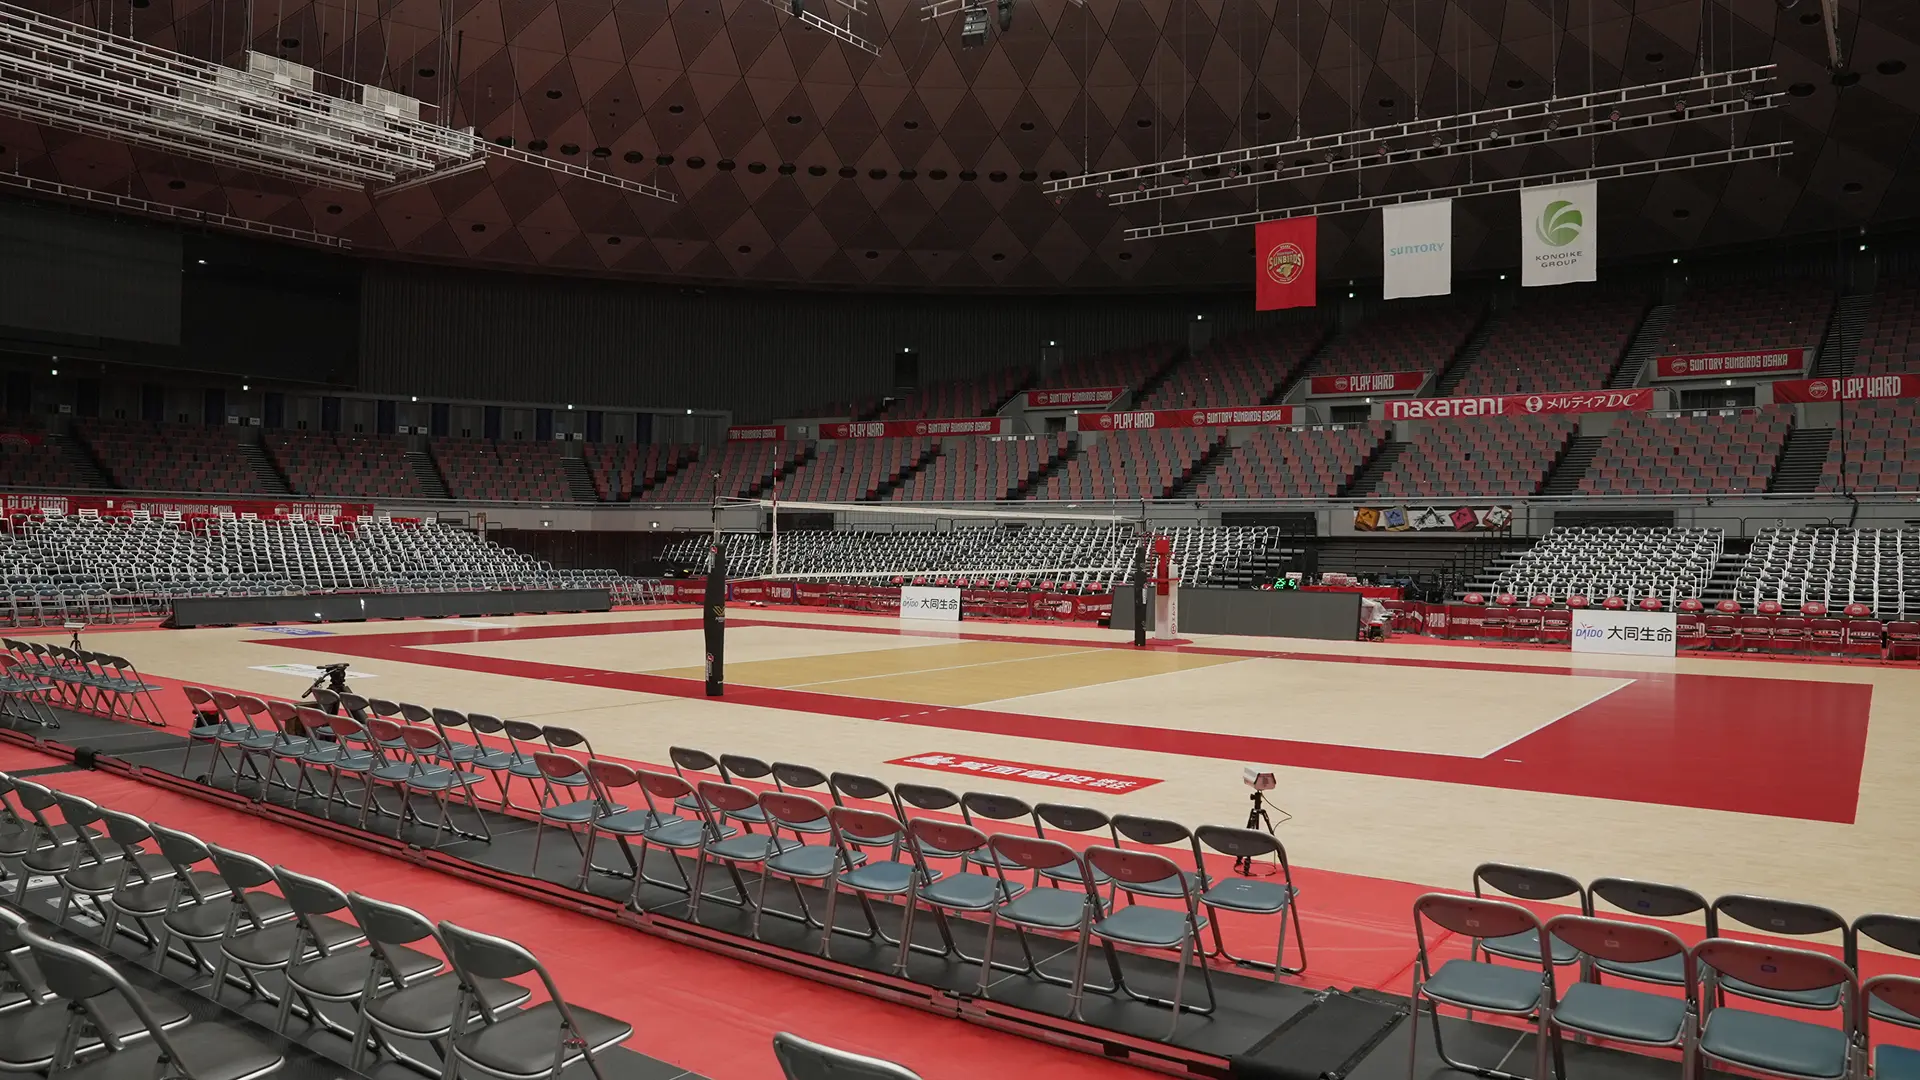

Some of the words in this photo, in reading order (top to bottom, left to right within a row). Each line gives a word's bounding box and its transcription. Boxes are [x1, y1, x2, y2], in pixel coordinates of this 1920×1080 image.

[1390, 243, 1445, 256] SUNTORY
[1535, 250, 1583, 261] KONOIKE
[1541, 259, 1577, 268] GROUP
[1690, 359, 1724, 371] SUNTORY
[1725, 356, 1761, 369] SUNBIRDS
[1763, 354, 1788, 367] OSAKA
[1350, 376, 1370, 391] PLAY
[1372, 374, 1394, 390] HARD
[1832, 378, 1864, 399] PLAY
[1866, 376, 1901, 397] HARD
[1114, 414, 1133, 429] PLAY
[1135, 413, 1154, 428] HARD
[1207, 413, 1232, 424] SUNTORY
[849, 424, 865, 437] PLAY
[1776, 519, 1784, 527] 3
[920, 599, 958, 610] 大同生命
[1576, 627, 1603, 639] DAIDO
[1607, 625, 1673, 642] 大同生命
